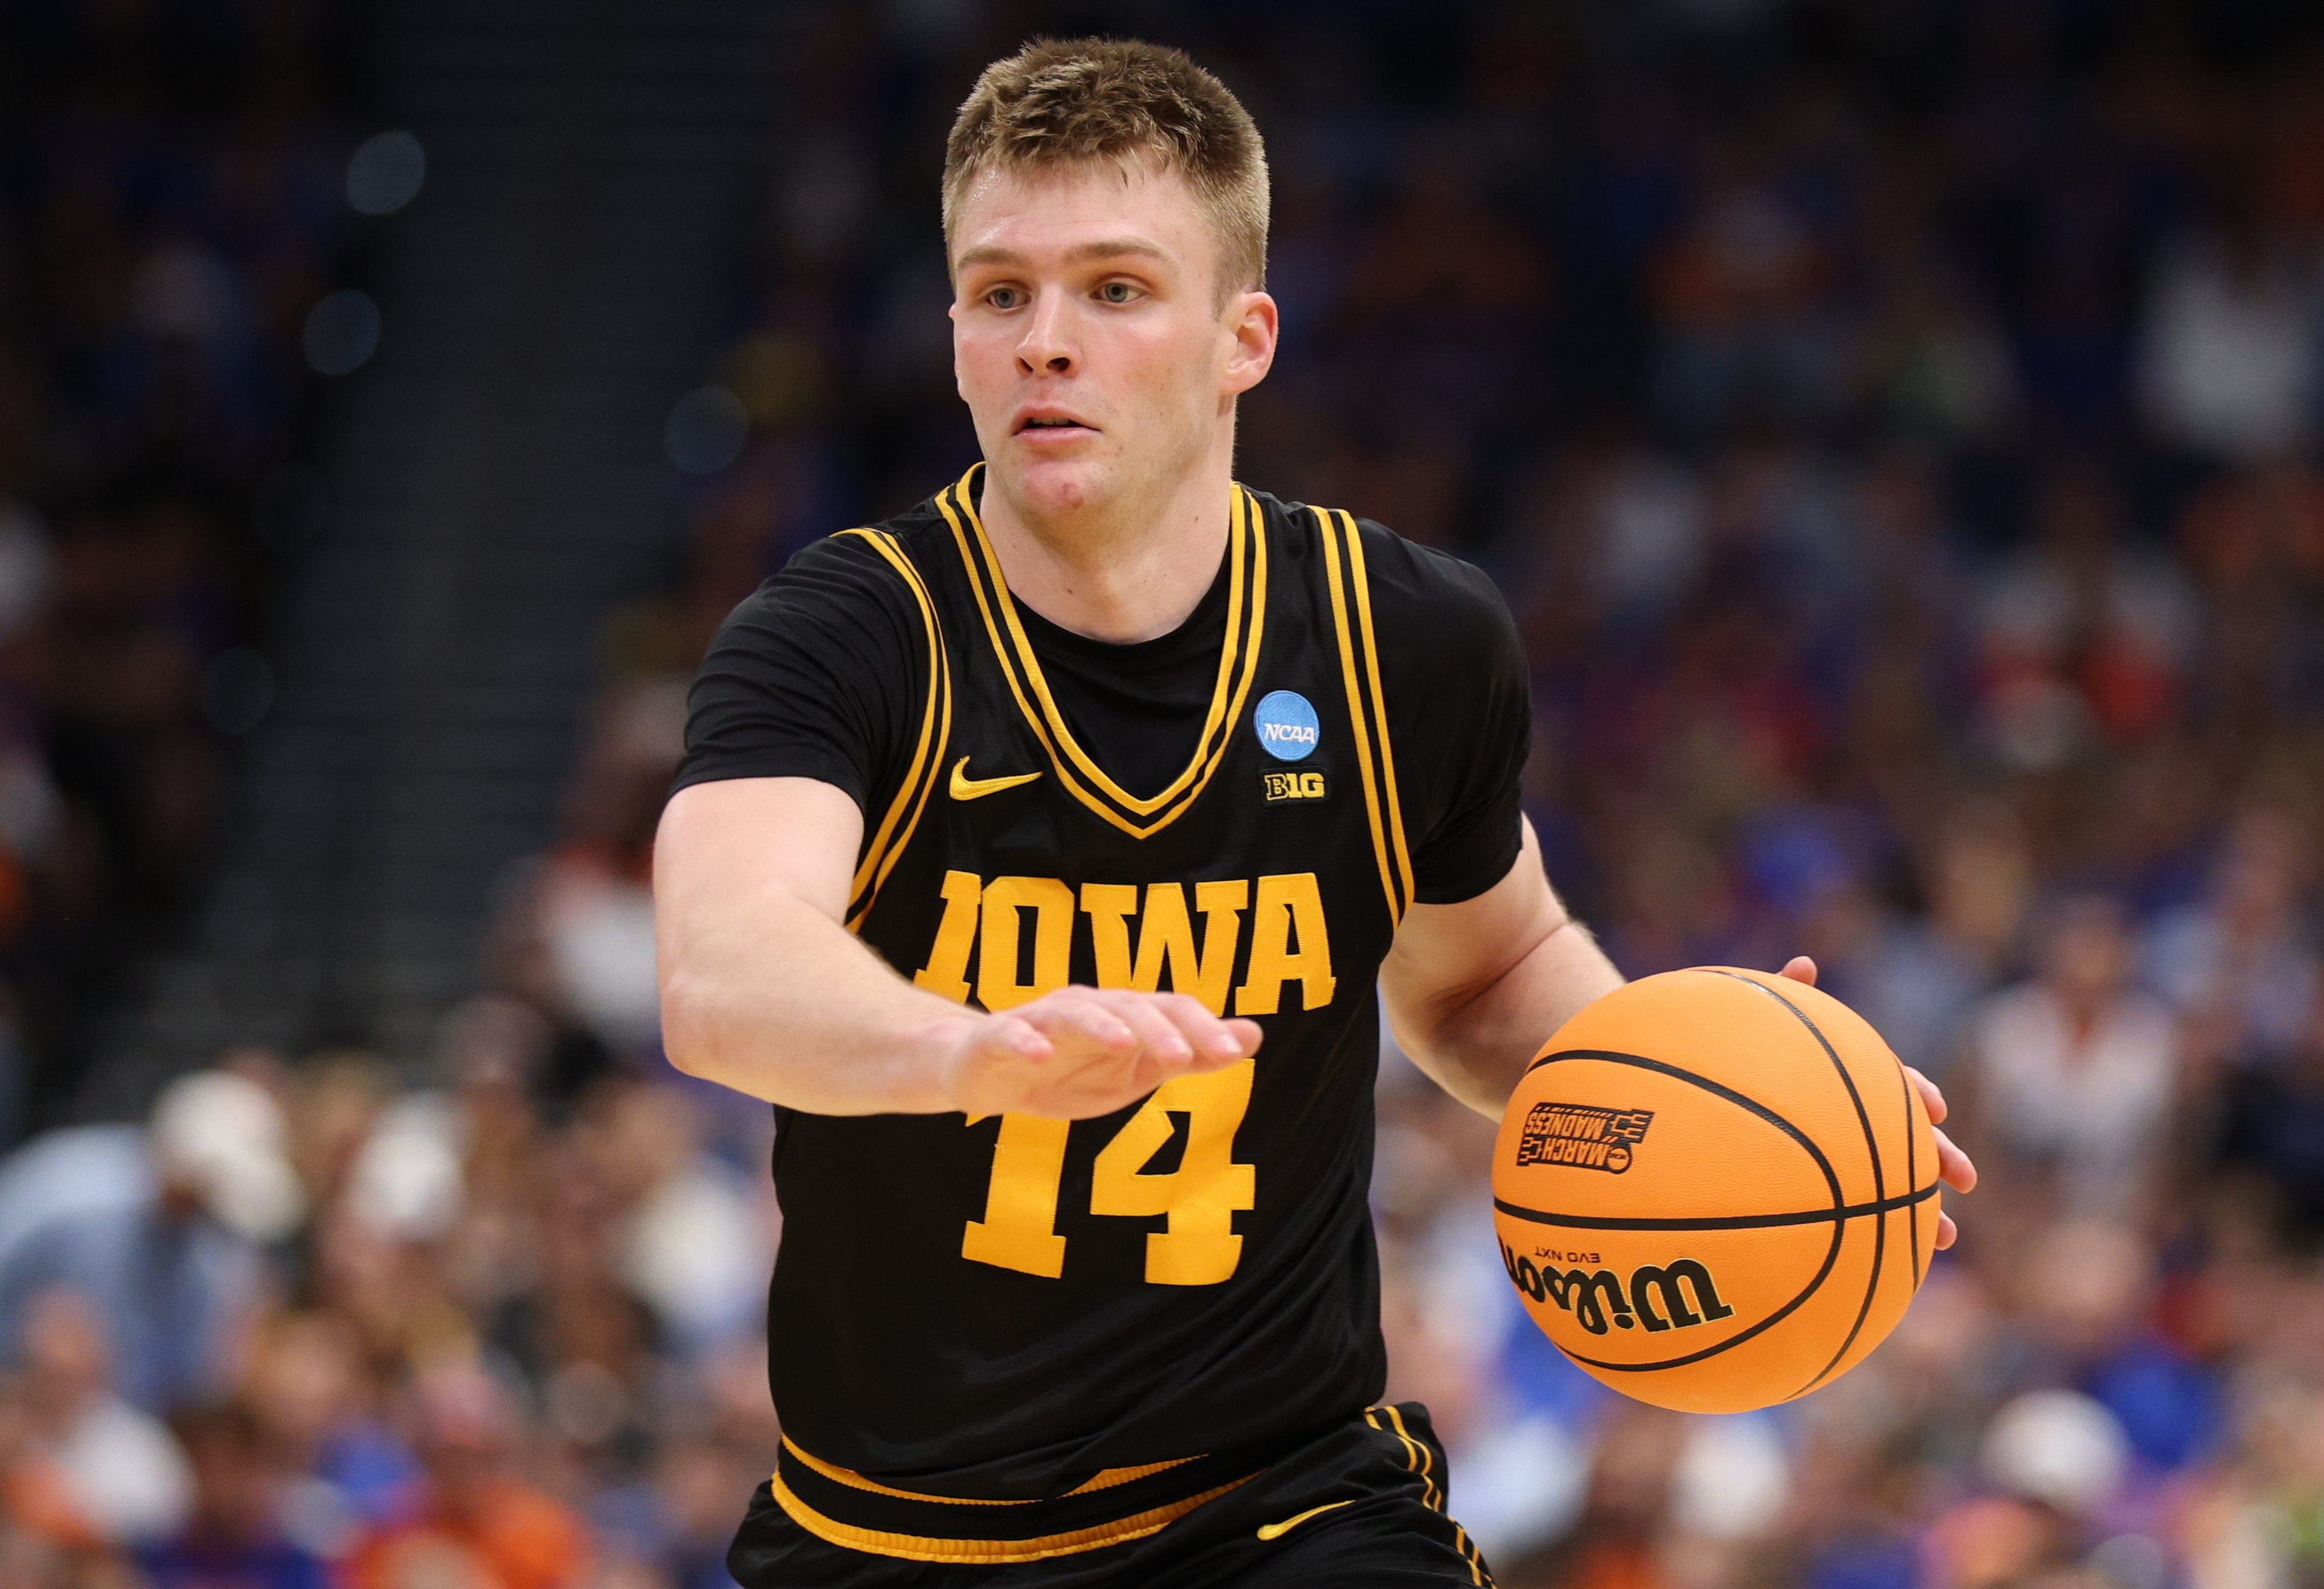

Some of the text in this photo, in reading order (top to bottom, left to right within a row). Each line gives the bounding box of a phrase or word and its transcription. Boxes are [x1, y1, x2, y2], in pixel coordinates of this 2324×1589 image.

[1264, 722, 1316, 744] NCAA
[913, 870, 1337, 1017] IOWA
[1525, 1112, 1608, 1140] MADNESS
[1541, 1137, 1611, 1167] MARCH
[961, 1058, 1256, 1286] 14
[1535, 1246, 1601, 1263] EVO NXT
[1498, 1233, 1736, 1336] Wilson
